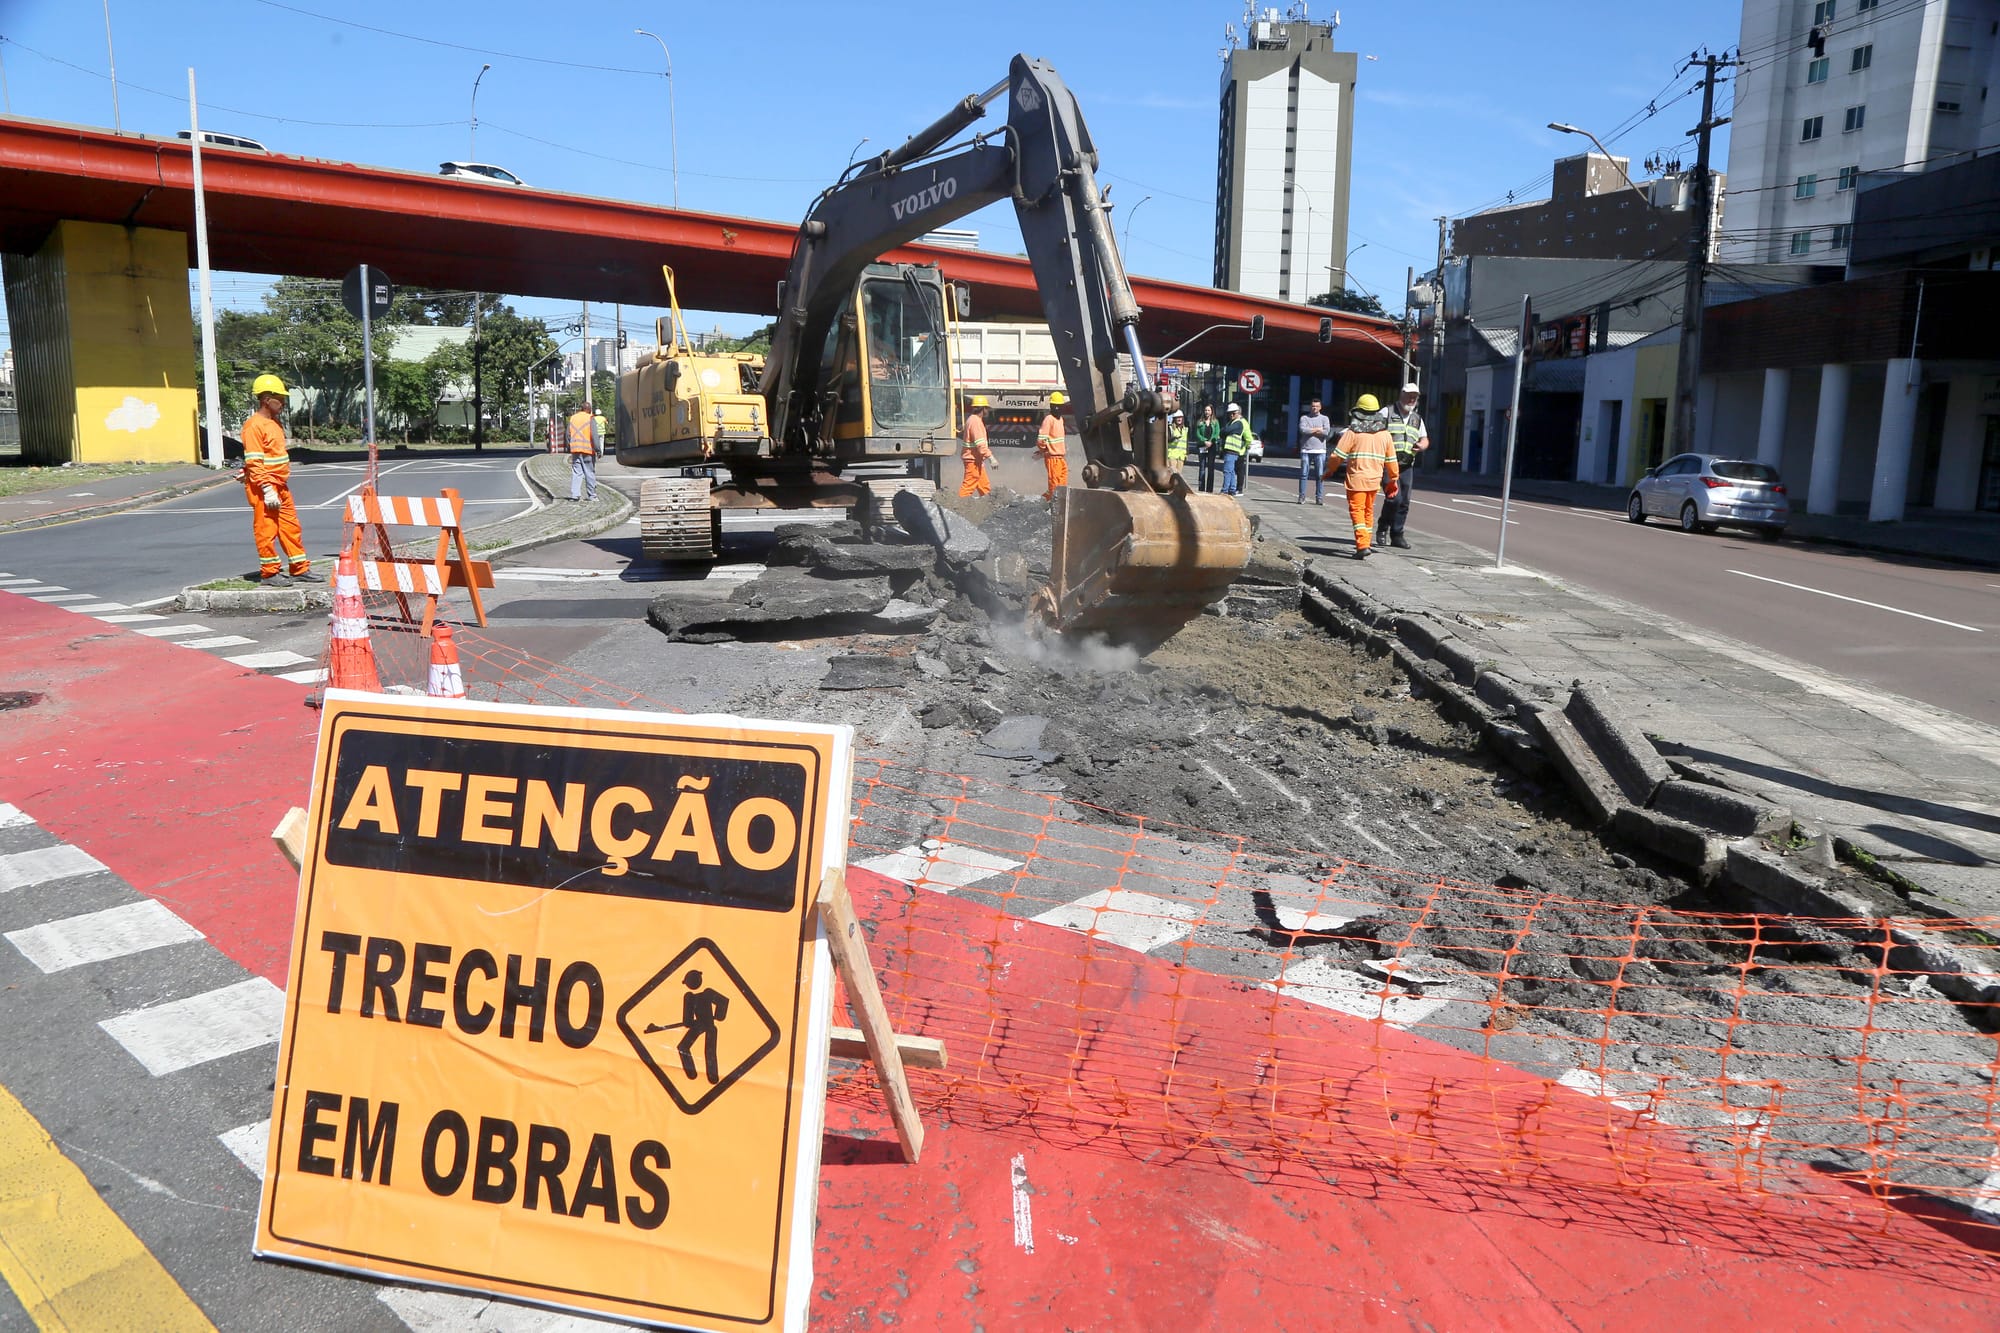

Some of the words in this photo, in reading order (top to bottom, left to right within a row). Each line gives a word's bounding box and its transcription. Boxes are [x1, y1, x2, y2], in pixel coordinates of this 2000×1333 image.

[891, 177, 957, 220] VOLVO
[642, 403, 666, 419] VOLVO
[338, 766, 796, 876] ATENÇÃO
[321, 931, 604, 1049] TRECHO
[298, 1090, 399, 1186] EM
[421, 1109, 671, 1230] OBRAS
